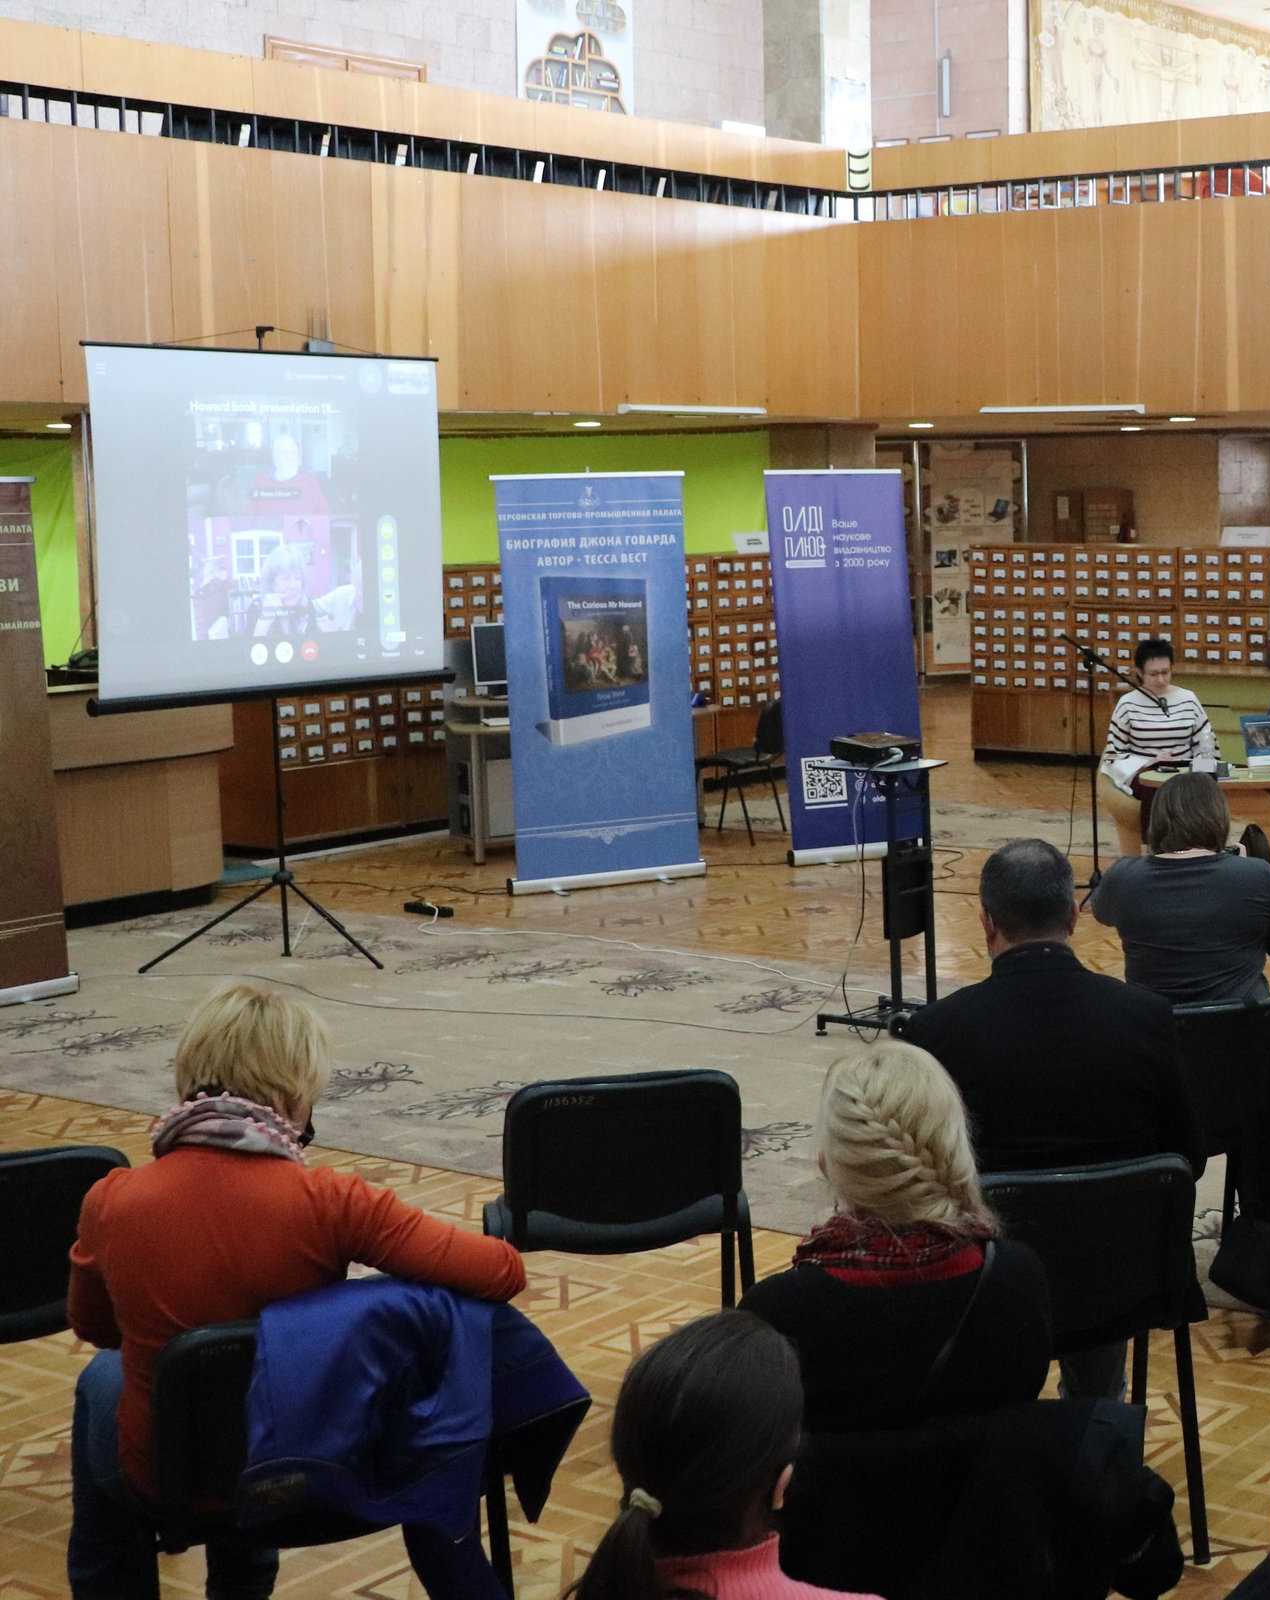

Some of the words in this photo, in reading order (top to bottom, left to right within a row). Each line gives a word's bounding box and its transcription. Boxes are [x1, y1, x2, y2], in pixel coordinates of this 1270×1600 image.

[190, 400, 229, 413] Howard
[231, 400, 256, 413] book
[259, 402, 320, 415] presentation
[652, 508, 682, 517] ПАЛАТА
[831, 518, 858, 529] Ваше
[505, 537, 577, 551] БИОГРАФИЯ
[579, 535, 623, 549] ДЖОНА
[625, 533, 677, 547] ГОВАРДА
[832, 533, 872, 543] наукове
[833, 545, 892, 555] видавництво
[536, 555, 574, 568] АВТОР
[584, 553, 618, 566] ТЕССА
[620, 552, 648, 565] ВЕСТ
[843, 558, 865, 568] 2000
[866, 559, 890, 569] року
[567, 600, 581, 609] The
[582, 600, 608, 609] Curious
[608, 600, 618, 609] Mr
